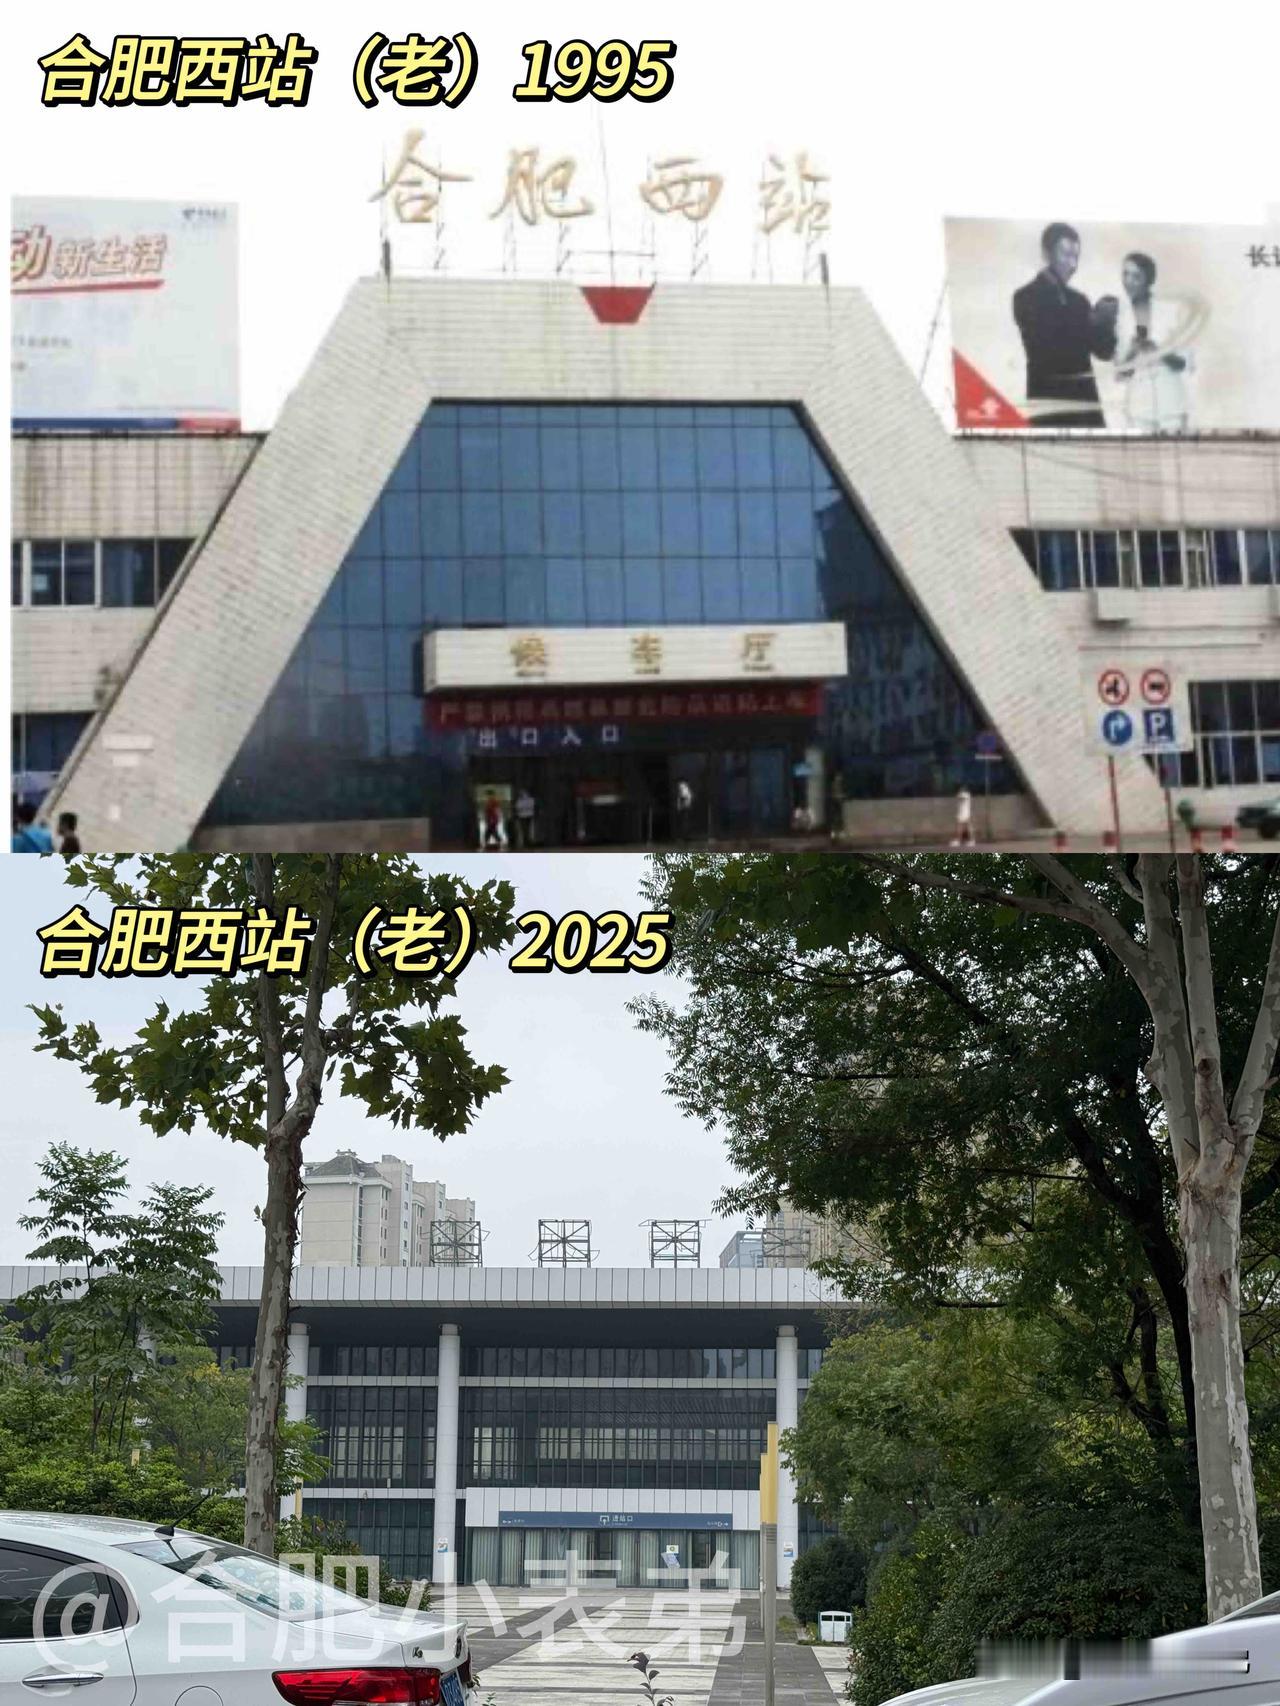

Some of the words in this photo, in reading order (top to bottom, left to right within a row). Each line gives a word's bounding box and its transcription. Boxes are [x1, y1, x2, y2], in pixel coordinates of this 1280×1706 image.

[369, 128, 831, 234] 合肥西站
[1243, 244, 1280, 267] 长
[1150, 713, 1167, 739] P
